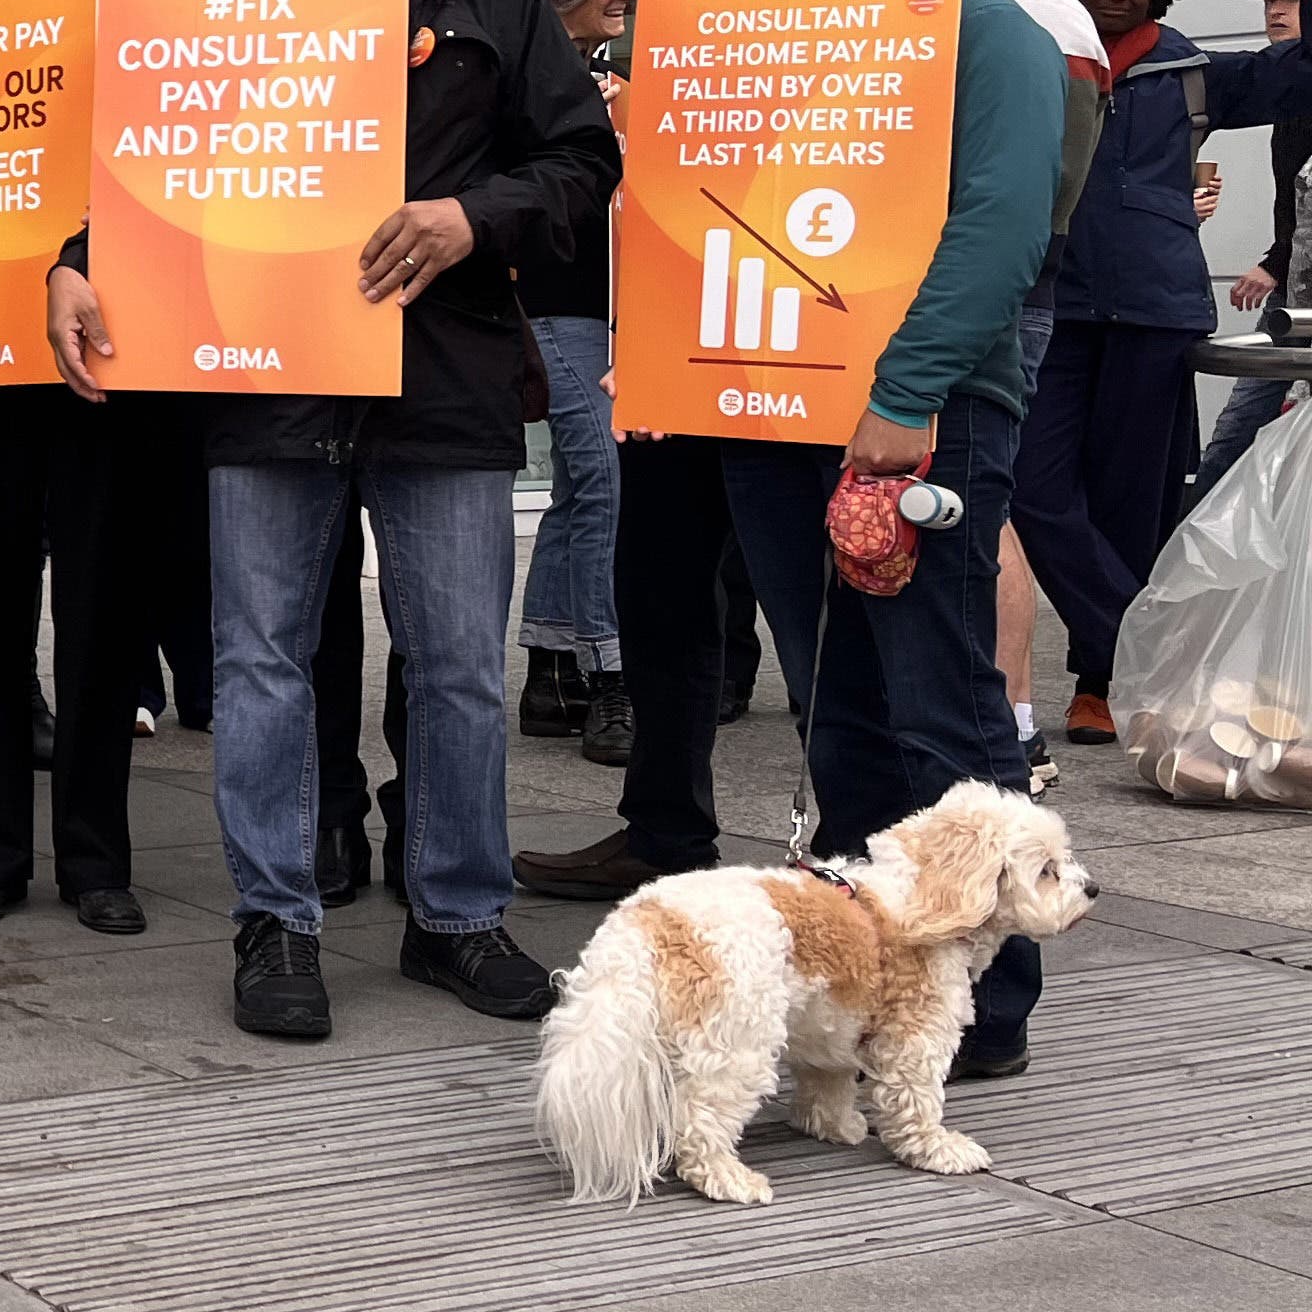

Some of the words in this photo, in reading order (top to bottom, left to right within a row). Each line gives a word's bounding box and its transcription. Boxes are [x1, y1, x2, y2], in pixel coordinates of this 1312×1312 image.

[16, 17, 64, 49] PAY
[699, 4, 885, 34] CONSULTANT
[119, 29, 384, 70] CONSULTANT
[649, 41, 808, 68] TAKE-HOME
[816, 39, 867, 62] PAY
[875, 37, 935, 61] HAS
[6, 66, 63, 97] OUR
[161, 80, 229, 112] PAY
[240, 76, 335, 109] NOW
[673, 76, 773, 100] FALLEN
[781, 75, 816, 97] BY
[822, 73, 902, 96] OVER
[658, 112, 676, 133] A
[682, 110, 763, 132] THIRD
[770, 108, 848, 131] OVER
[855, 107, 913, 130] THE
[114, 125, 198, 156] AND
[210, 122, 288, 154] FOR
[297, 120, 379, 152] THE
[680, 143, 746, 165] LAST
[754, 143, 783, 165] 14
[791, 142, 884, 165] YEARS
[166, 166, 323, 199] FUTURE
[806, 203, 833, 242] £
[223, 348, 281, 369] BMA
[747, 392, 807, 418] BMA
